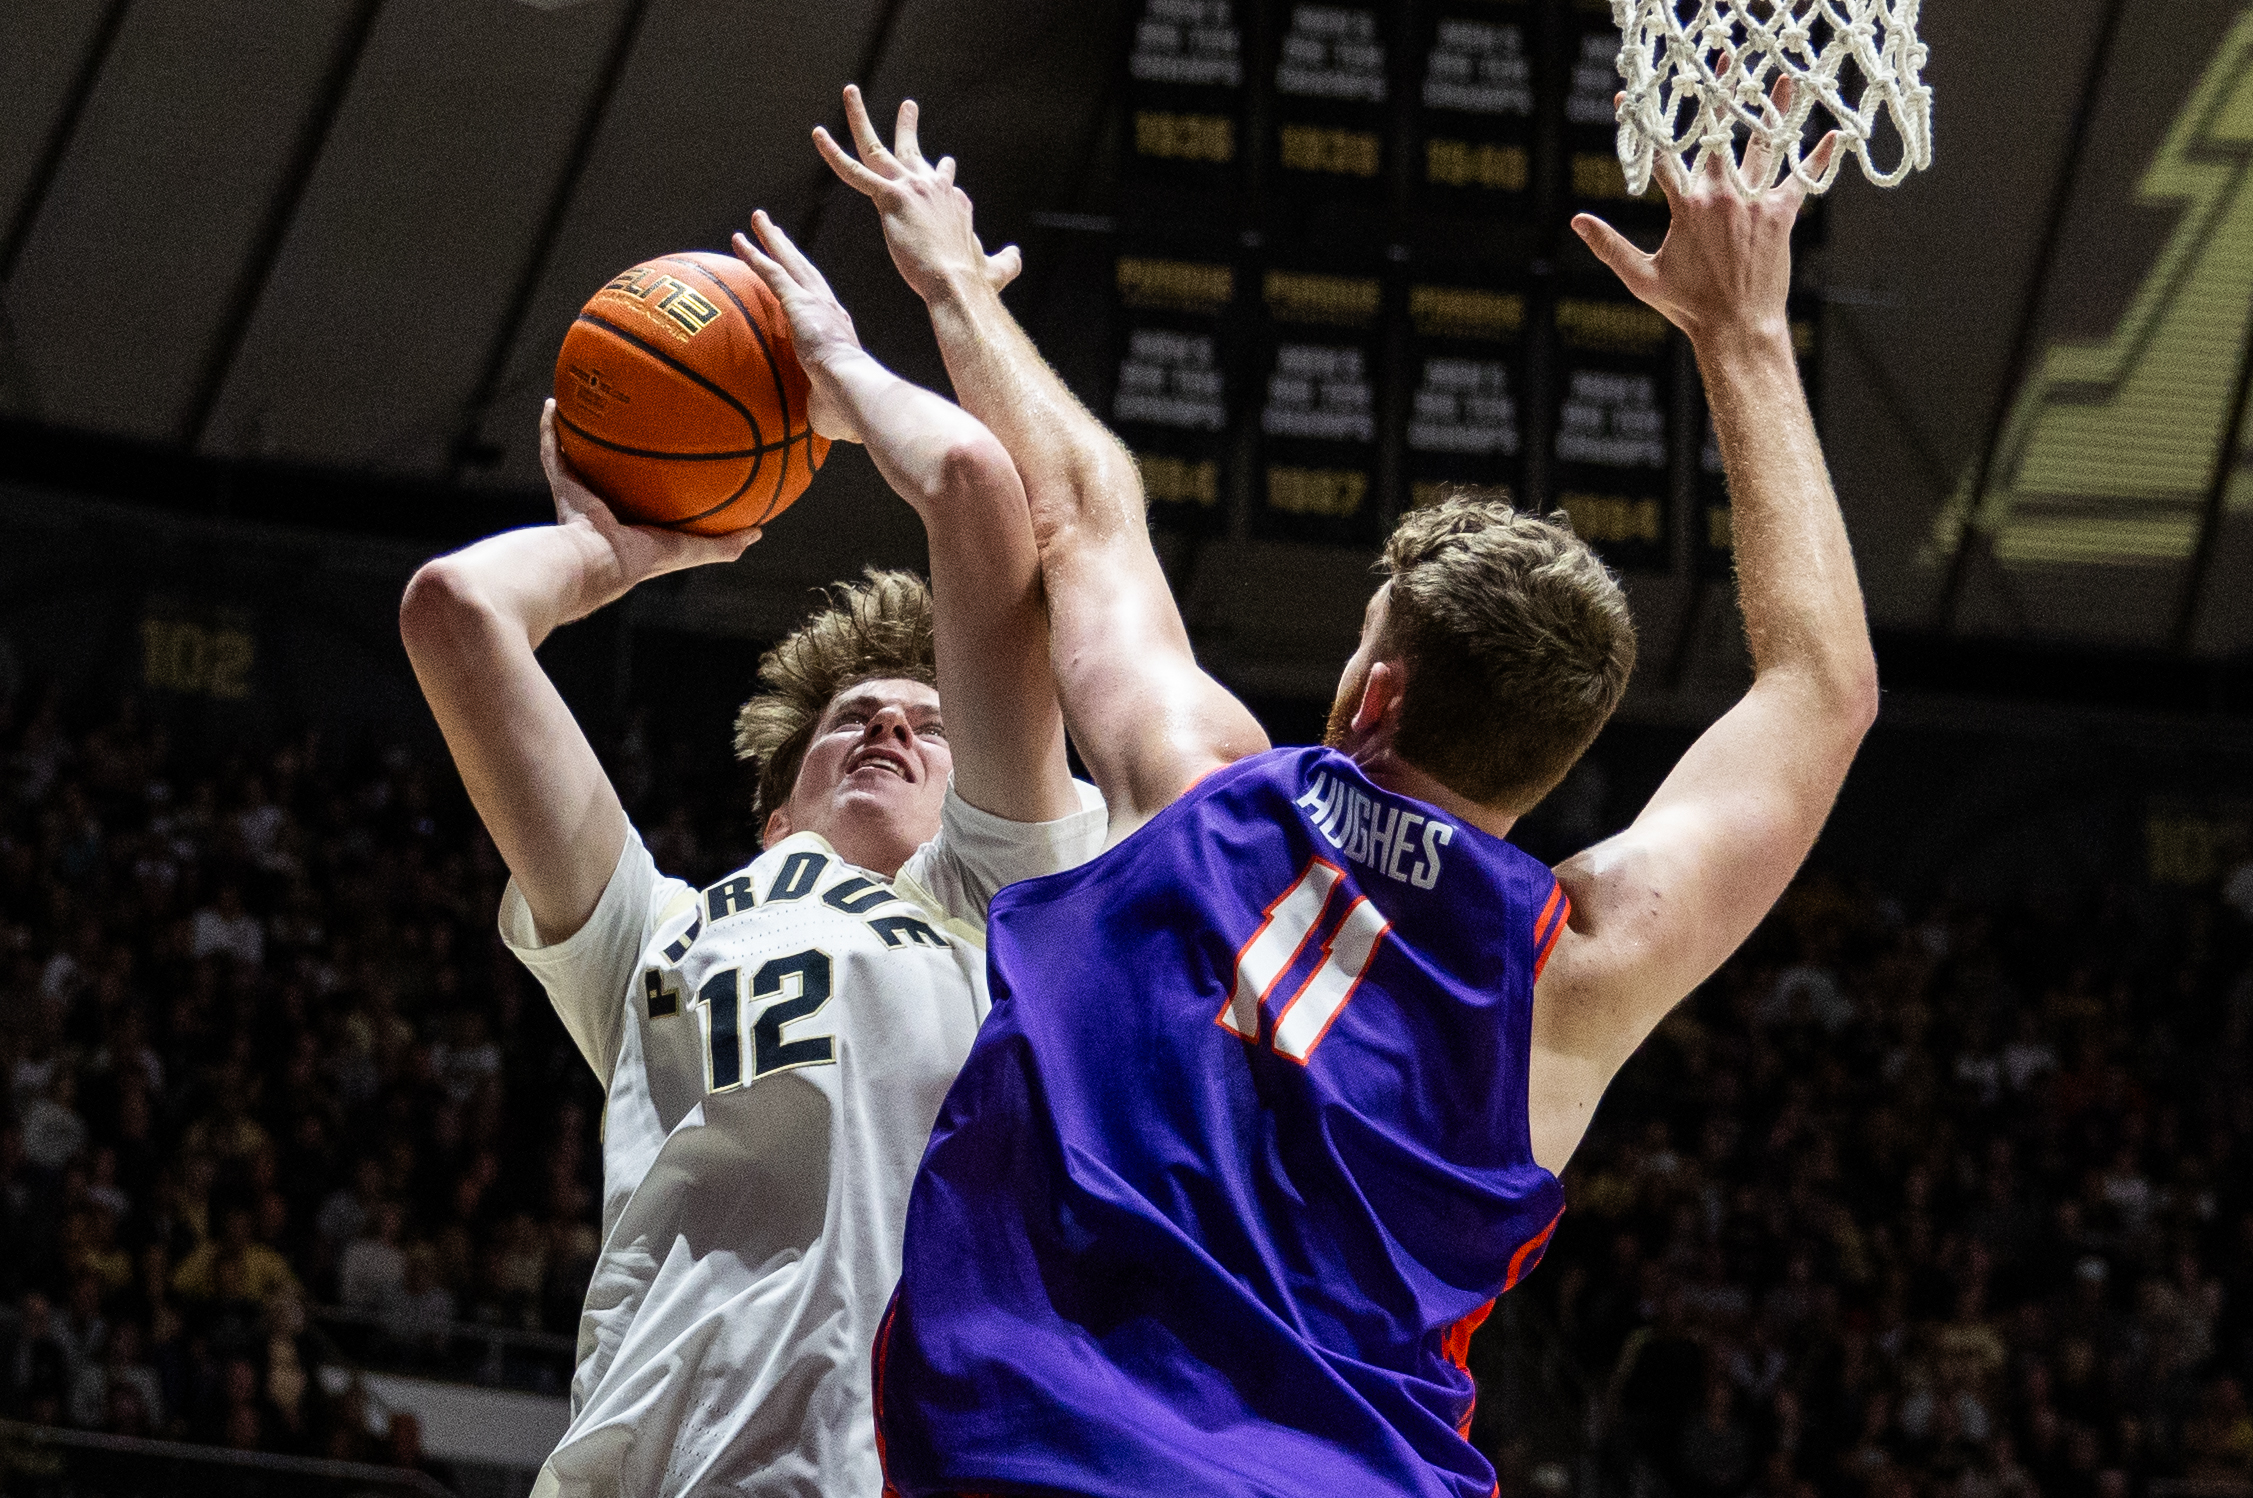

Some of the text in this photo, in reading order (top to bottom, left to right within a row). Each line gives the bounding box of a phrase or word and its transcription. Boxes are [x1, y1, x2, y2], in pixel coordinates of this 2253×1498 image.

[139, 618, 254, 698] 102
[1296, 771, 1454, 890] HUGHES
[696, 947, 837, 1095] 12
[1213, 854, 1395, 1067] 11
